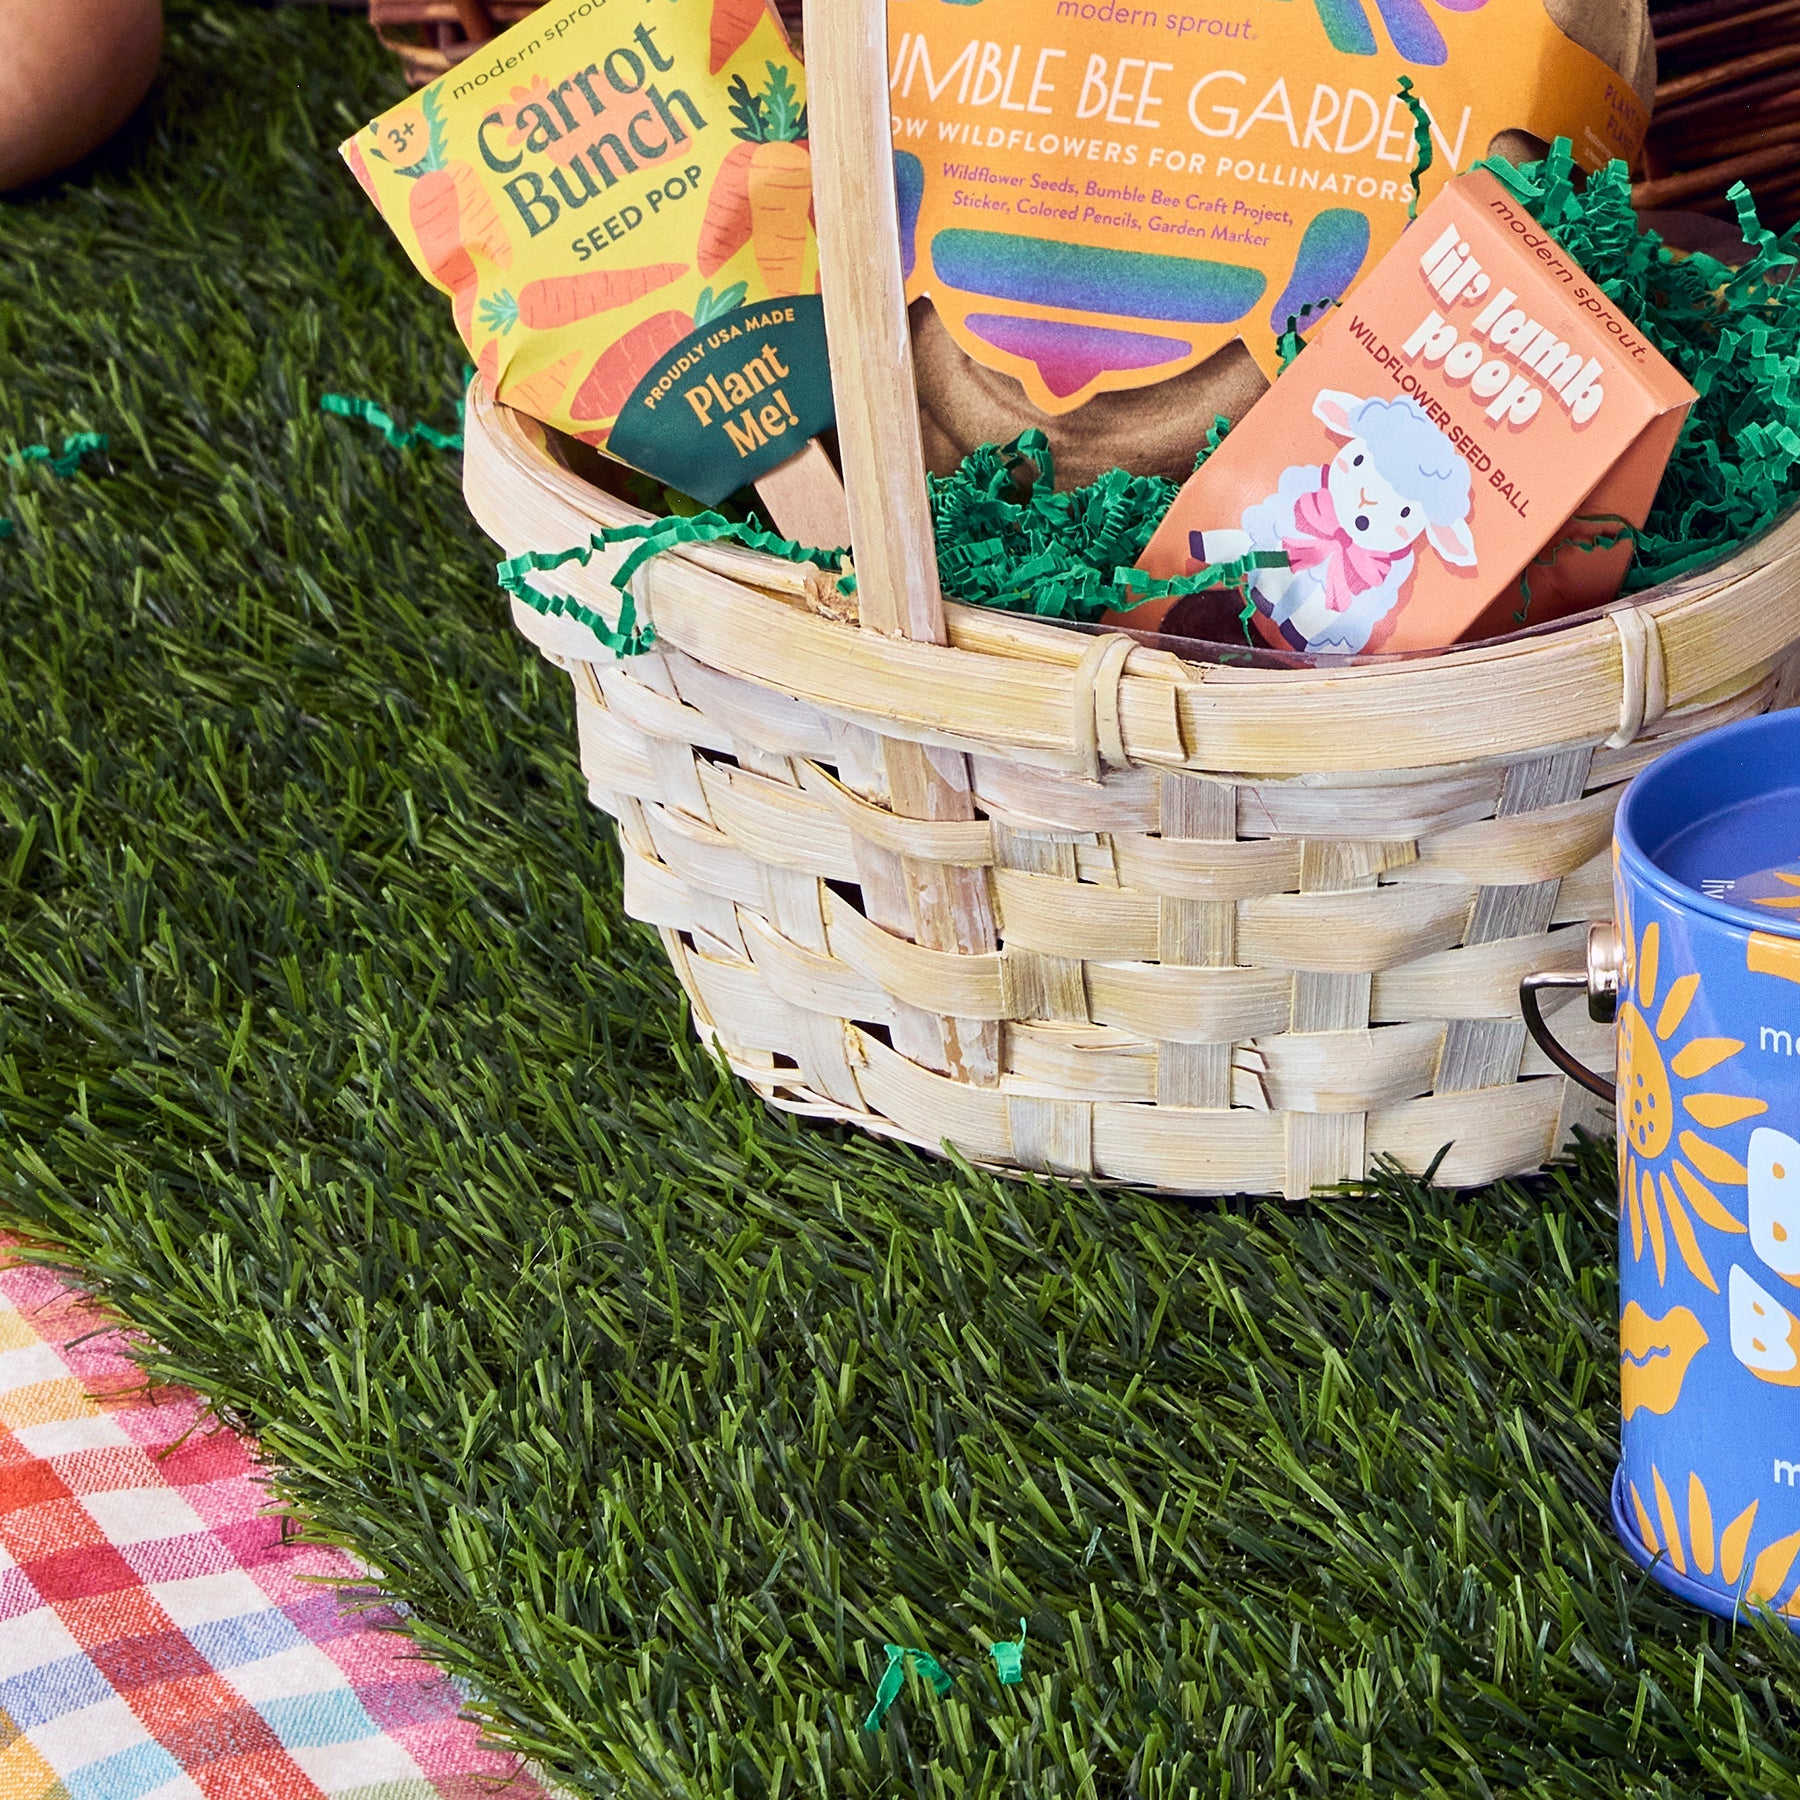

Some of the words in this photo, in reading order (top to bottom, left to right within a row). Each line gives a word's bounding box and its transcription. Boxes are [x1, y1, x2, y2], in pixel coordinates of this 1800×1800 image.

[451, 38, 543, 100] modern
[477, 20, 676, 175] Carrot
[889, 32, 1067, 116] UMBLE
[1076, 53, 1175, 129] BEE
[1187, 70, 1473, 172] GARDEN
[386, 118, 418, 153] 3+
[502, 82, 709, 238] Bunch
[937, 119, 1138, 166] WILDFLOWERS
[1148, 148, 1207, 176] FOR
[1216, 155, 1416, 204] POLLINATORS
[571, 203, 644, 262] SEED
[651, 164, 704, 215] POP
[942, 161, 1026, 188] Wildflower
[1030, 172, 1080, 197] Seeds,
[1084, 180, 1147, 204] Bumble
[1150, 189, 1182, 208] Bee
[1185, 194, 1229, 215] Craft
[1231, 199, 1295, 227] Project,
[952, 190, 1012, 214] Sticker,
[1016, 199, 1079, 221] Colored
[1082, 206, 1142, 232] Pencils,
[1147, 216, 1207, 239] Garden
[1210, 224, 1271, 248] Marker
[1490, 200, 1574, 283] modern
[644, 342, 706, 410] PROUDLY
[707, 325, 743, 351] USA
[745, 306, 796, 331] MADE
[684, 343, 791, 428] Plant
[1402, 309, 1544, 428] poop
[1472, 287, 1605, 426] lamb
[722, 401, 800, 459] Me!
[1348, 314, 1452, 435] WILDFLOWER
[1447, 425, 1493, 477] SEED
[1488, 469, 1530, 520] BALL
